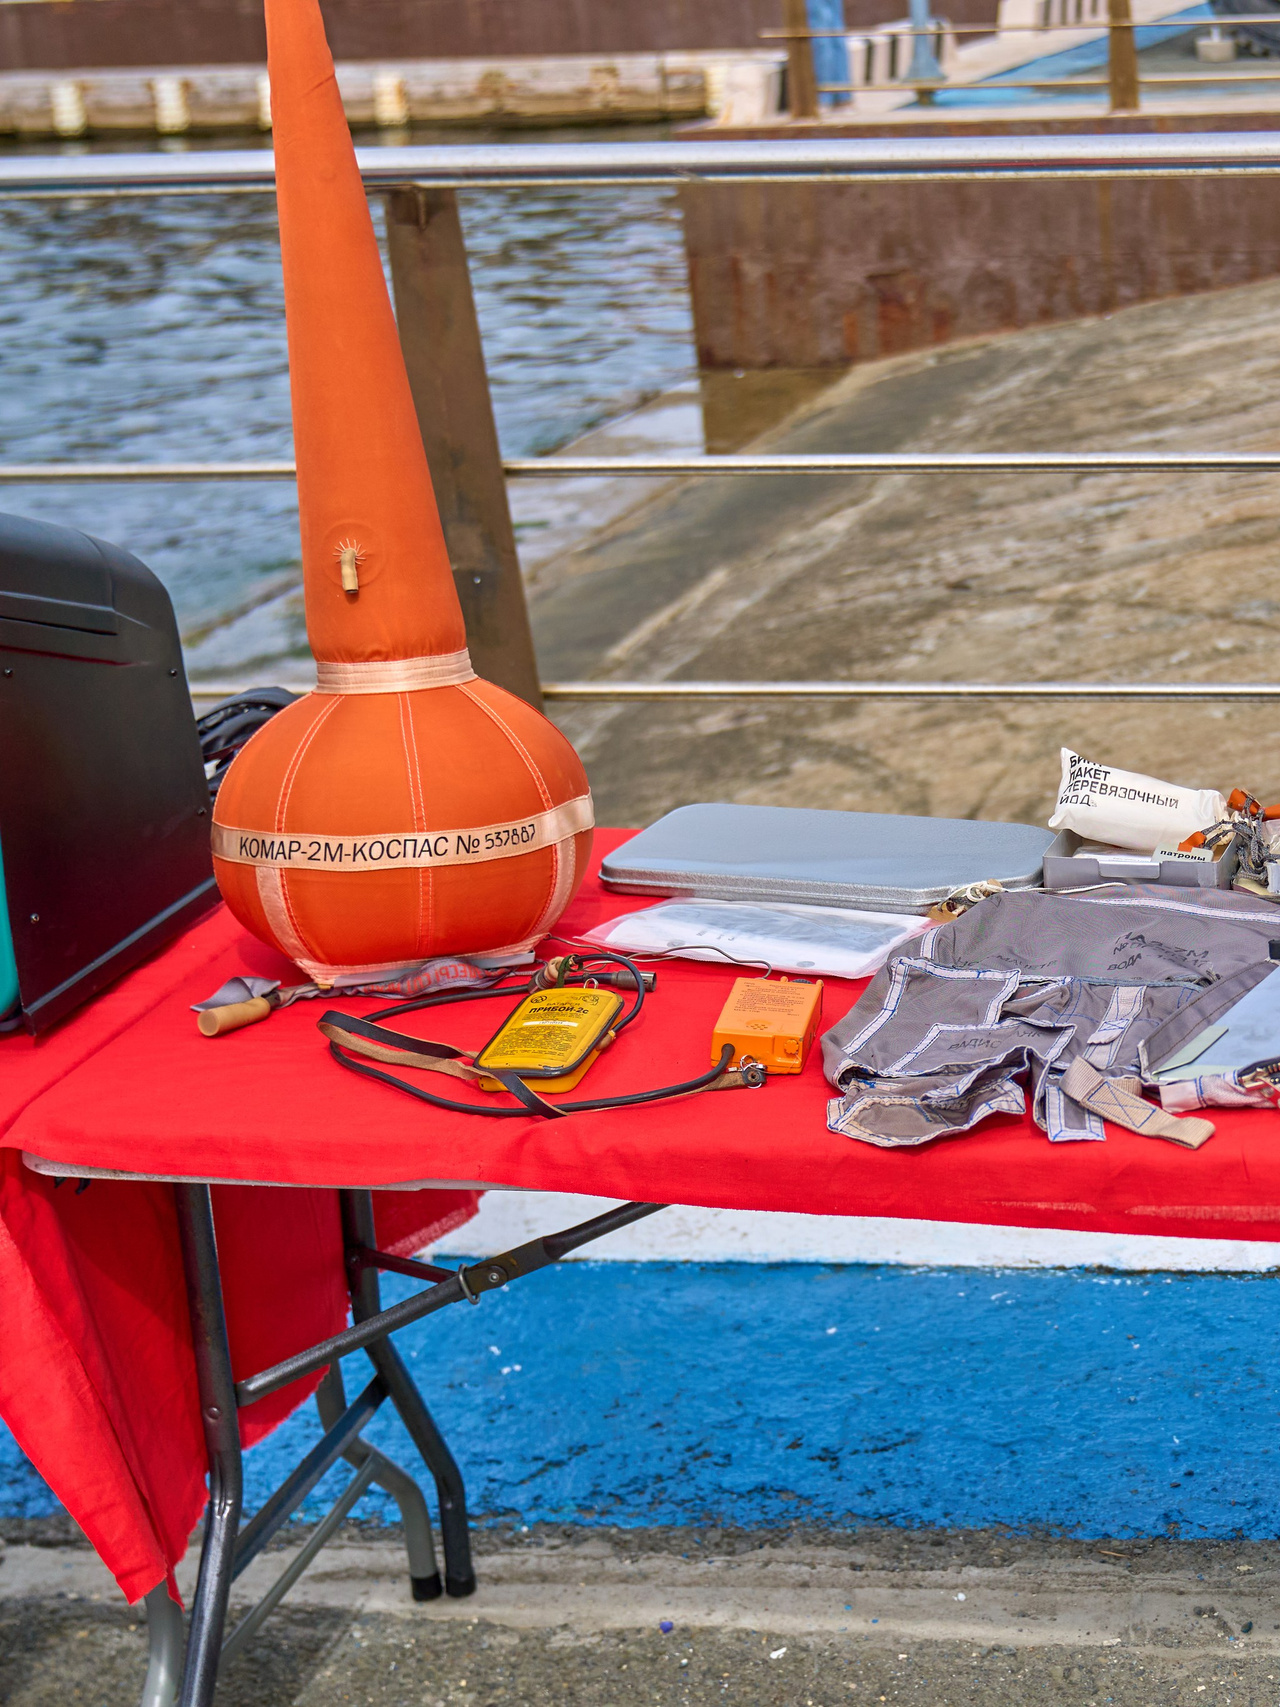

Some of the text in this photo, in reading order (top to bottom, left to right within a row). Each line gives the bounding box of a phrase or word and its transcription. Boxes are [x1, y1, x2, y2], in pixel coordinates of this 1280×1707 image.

[239, 823, 536, 863] КОМАР-2М-КОСПАС № 537887
[1160, 850, 1206, 862] патроны
